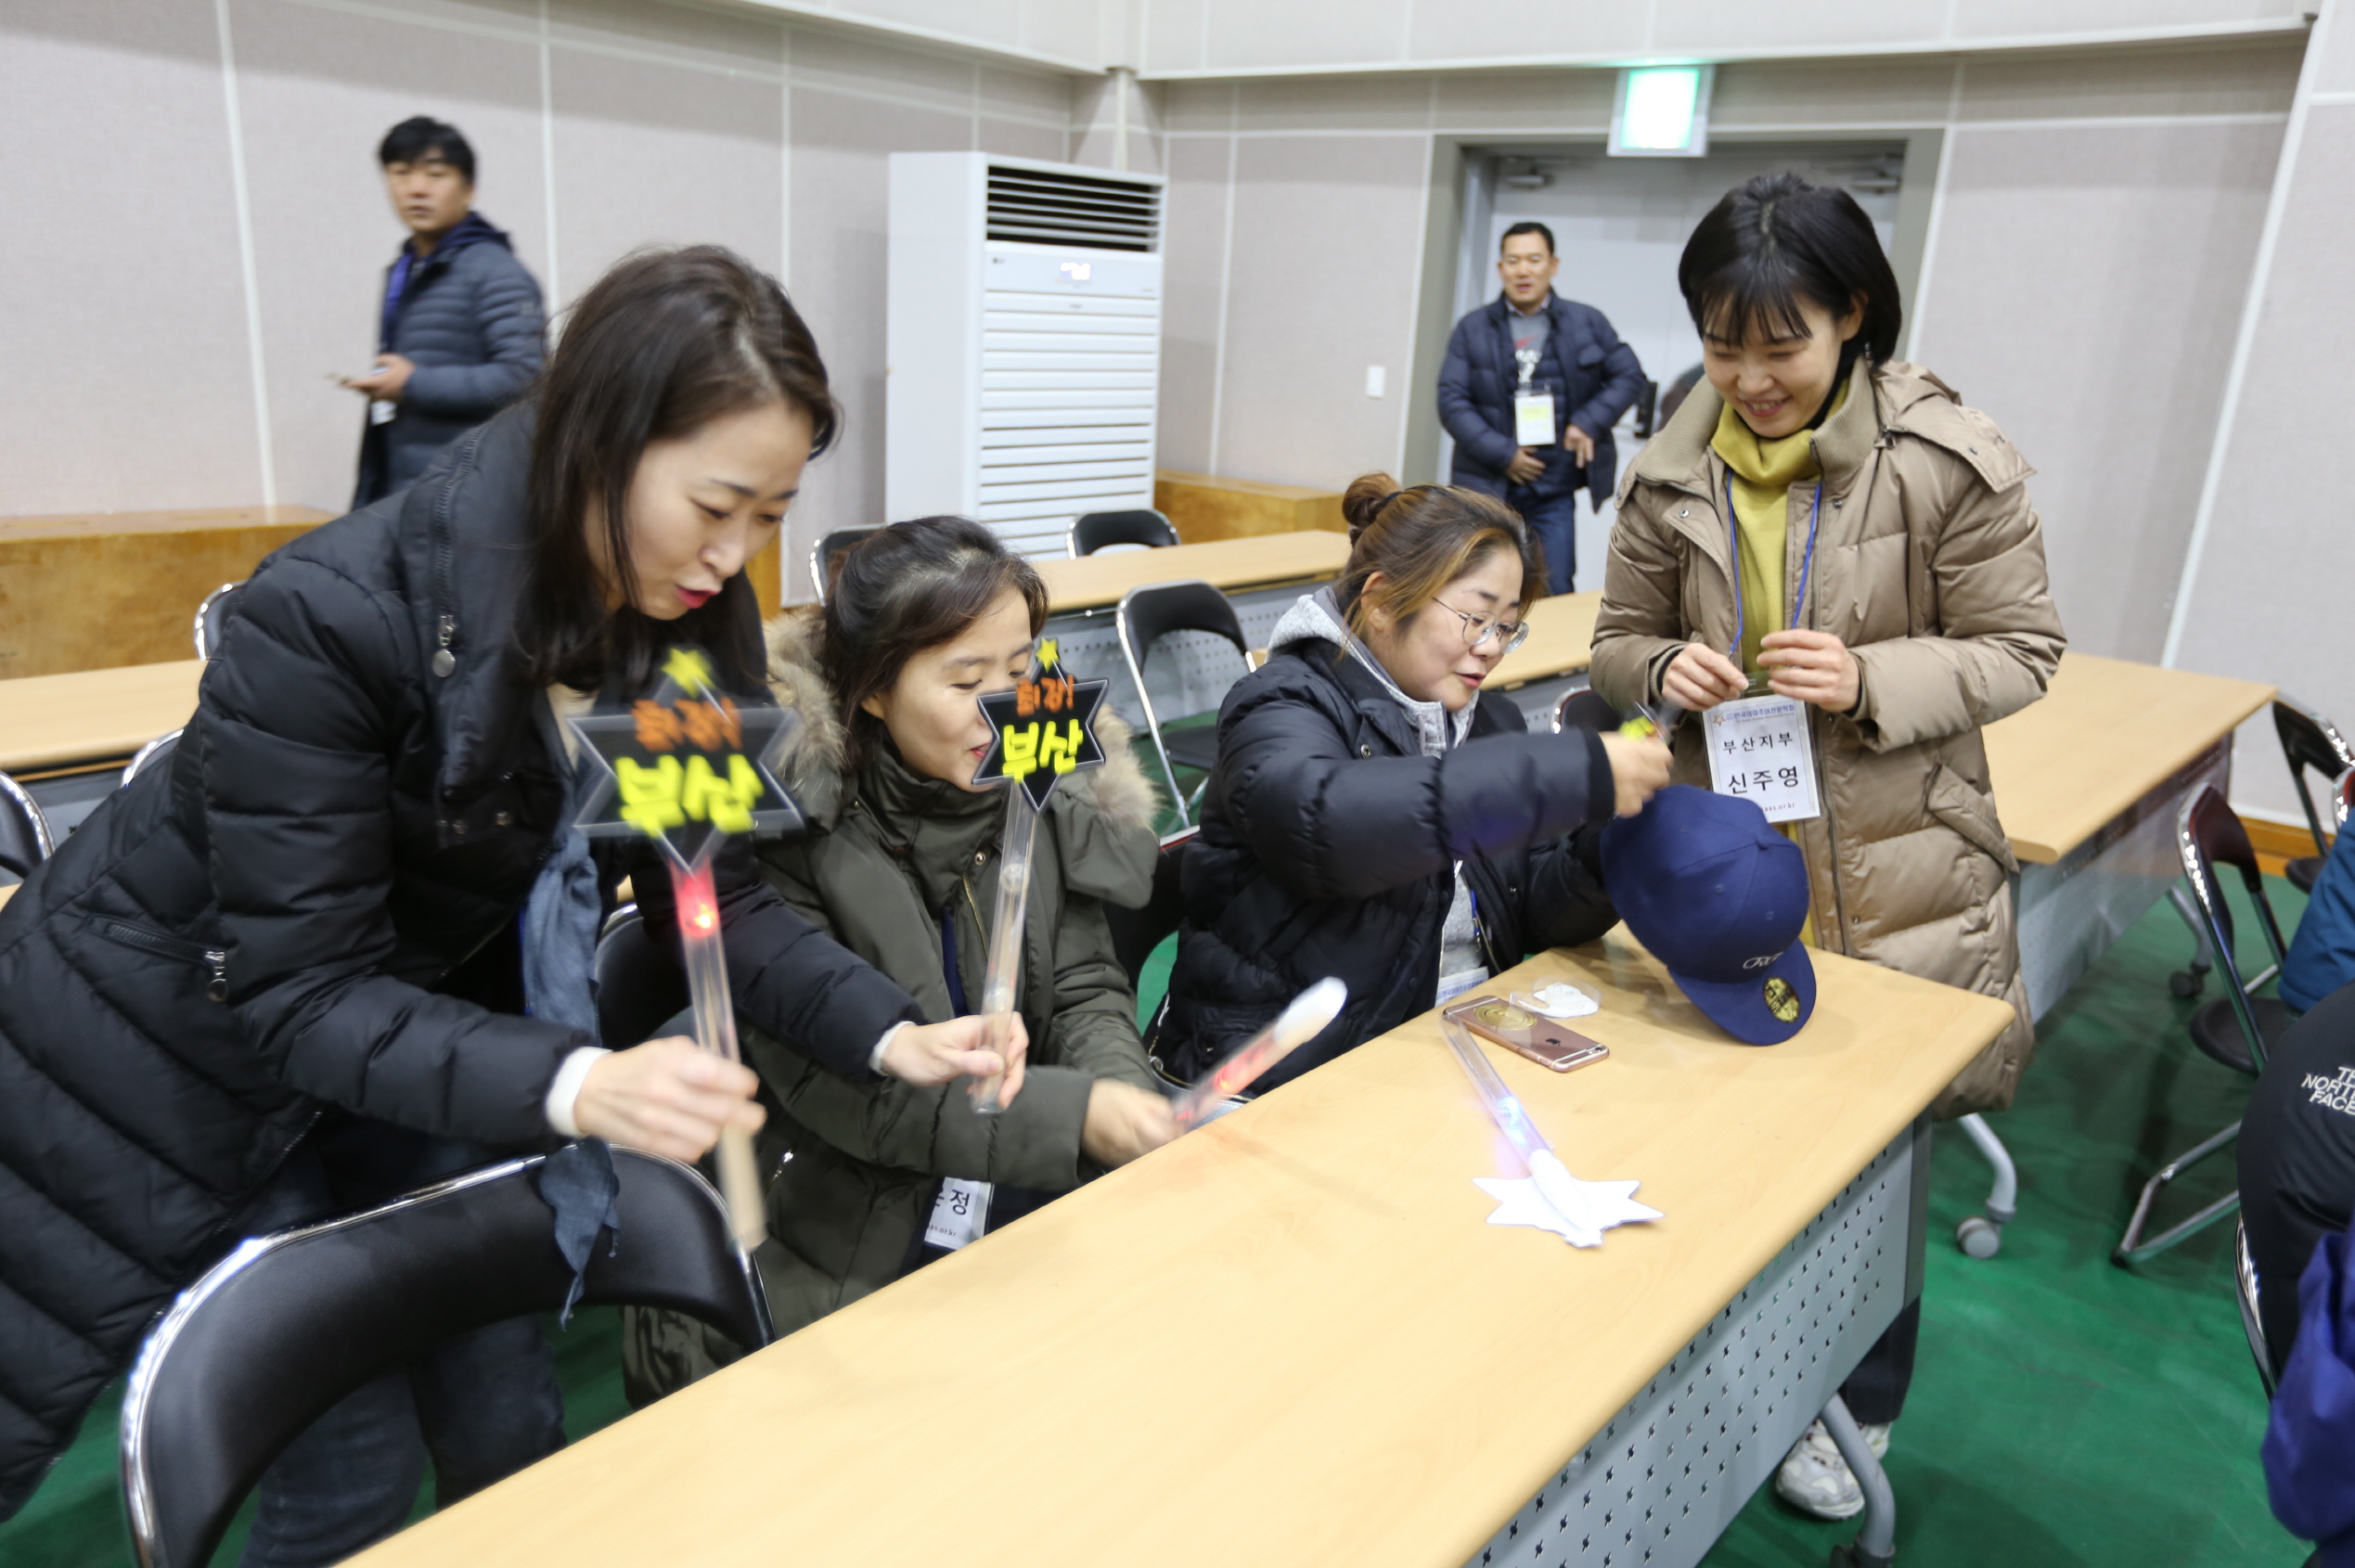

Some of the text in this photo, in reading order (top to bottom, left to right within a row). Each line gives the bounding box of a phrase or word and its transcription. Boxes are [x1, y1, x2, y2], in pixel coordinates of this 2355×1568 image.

[1003, 719, 1083, 783] 부산
[1723, 732, 1793, 754] 부산지부
[1728, 765, 1799, 795] 신주영
[616, 754, 764, 839] 부산
[2301, 1073, 2355, 1101] NORT
